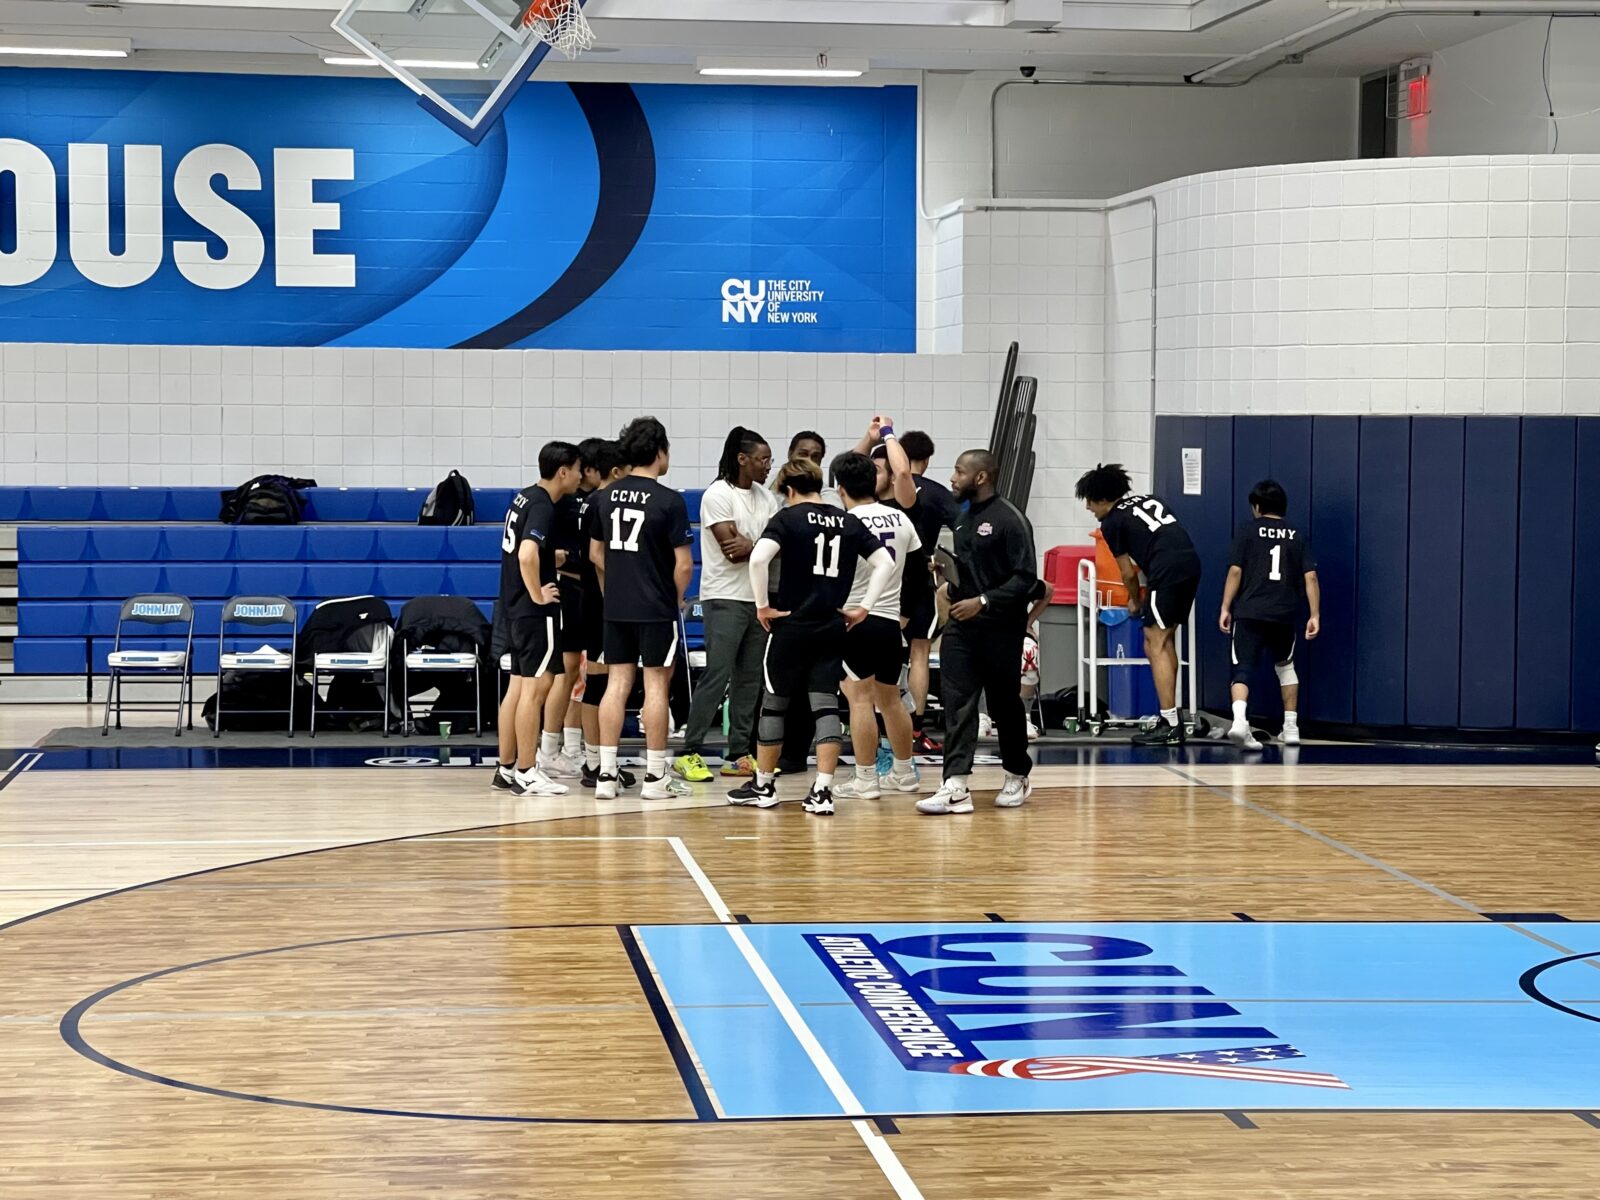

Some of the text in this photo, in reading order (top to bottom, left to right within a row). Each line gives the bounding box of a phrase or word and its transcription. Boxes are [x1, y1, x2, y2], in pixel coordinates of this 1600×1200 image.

[768, 280, 811, 291] THE CITY
[767, 291, 824, 302] UNIVERSITY
[767, 302, 780, 312] OF
[767, 312, 818, 323] NEW YORK
[611, 490, 651, 504] CCNY
[807, 512, 845, 528] CCNY
[1132, 499, 1177, 533] 12
[610, 507, 645, 552] 17
[1259, 526, 1297, 540] CCNY
[813, 532, 841, 578] 11
[1269, 545, 1281, 581] 1
[132, 602, 183, 616] JOHN JAY
[234, 604, 285, 618] JOHN JAY
[815, 936, 965, 1058] ATHLETIC CONFERENCE
